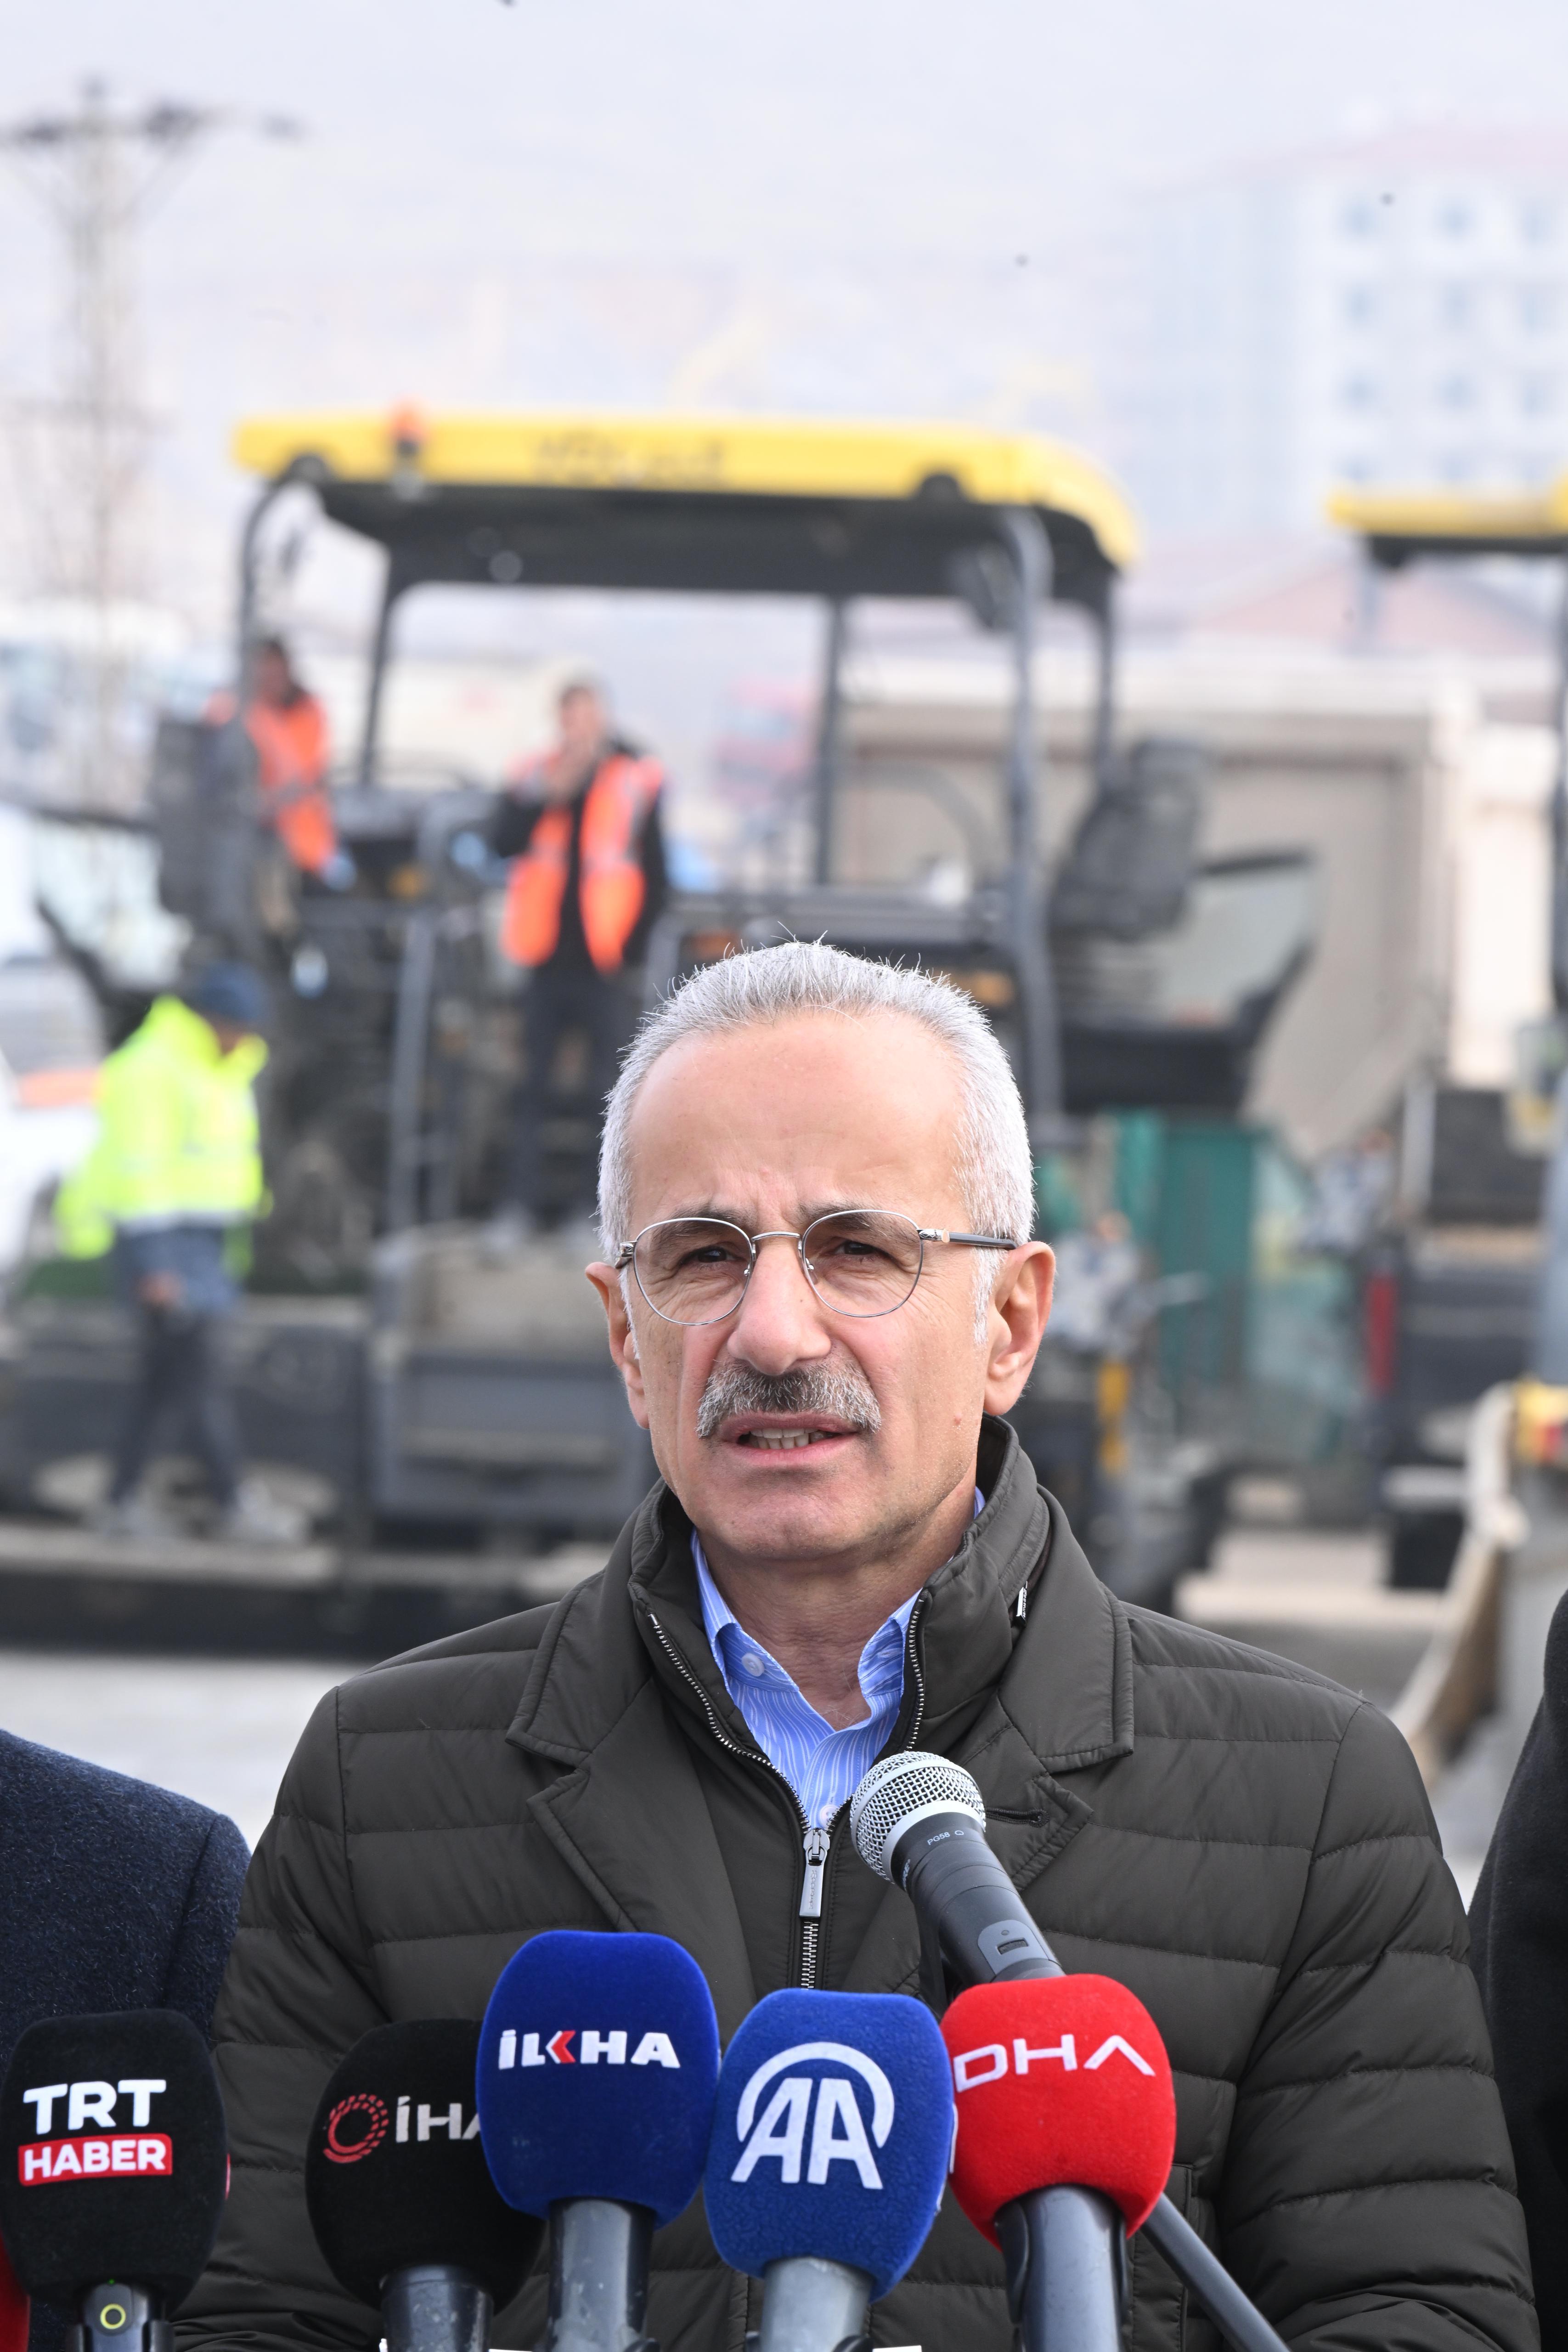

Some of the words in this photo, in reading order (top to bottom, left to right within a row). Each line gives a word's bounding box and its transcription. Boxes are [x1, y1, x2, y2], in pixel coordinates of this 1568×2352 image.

[927, 1832, 951, 1845] PG58
[953, 2034, 1156, 2092] DHA
[23, 2079, 167, 2135] TRT
[731, 2077, 883, 2190] AA
[24, 2138, 166, 2181] HABER
